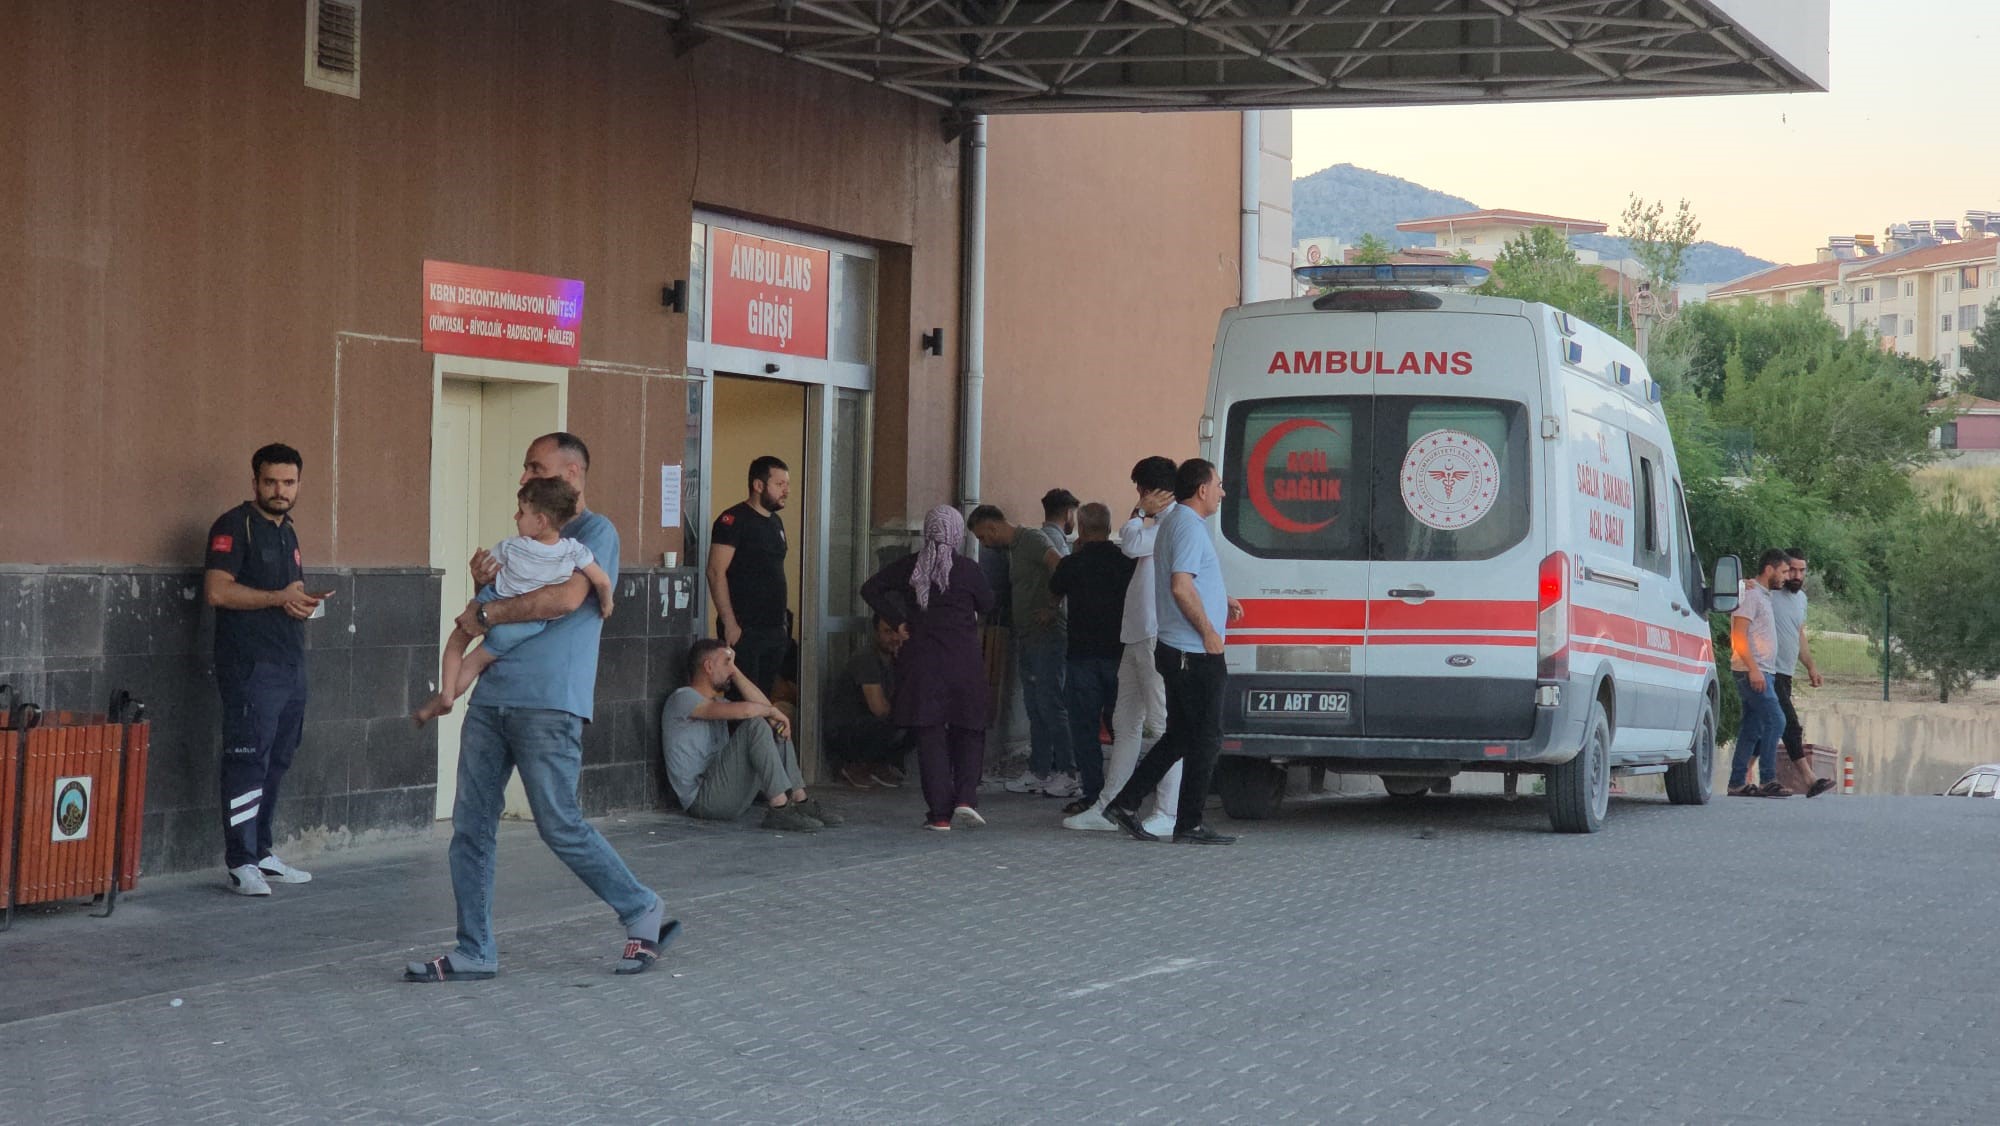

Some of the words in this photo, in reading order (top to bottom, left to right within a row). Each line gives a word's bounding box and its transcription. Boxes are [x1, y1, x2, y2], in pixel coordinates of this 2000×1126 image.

[730, 243, 812, 292] AMBULANS
[430, 282, 456, 303] KBRN
[458, 286, 545, 315] DEKONTAMİNASYON
[546, 294, 577, 319] ÜNİTESİ
[429, 311, 465, 334] (KİMYASAL
[470, 315, 503, 338] BİYOLOJİK
[506, 323, 544, 343] RADYASYON
[547, 325, 576, 348] NÜKLEER)
[748, 292, 793, 348] GİRİŞİ
[1267, 350, 1473, 376] AMBULANS
[1286, 448, 1328, 473] ACİL
[1273, 475, 1341, 502] SAĞLIK
[1577, 461, 1600, 499] SAĞLIK
[1604, 511, 1624, 547] SAĞLIK
[1258, 693, 1276, 711] 21
[1284, 693, 1312, 712] ABT
[1319, 694, 1346, 712] 092
